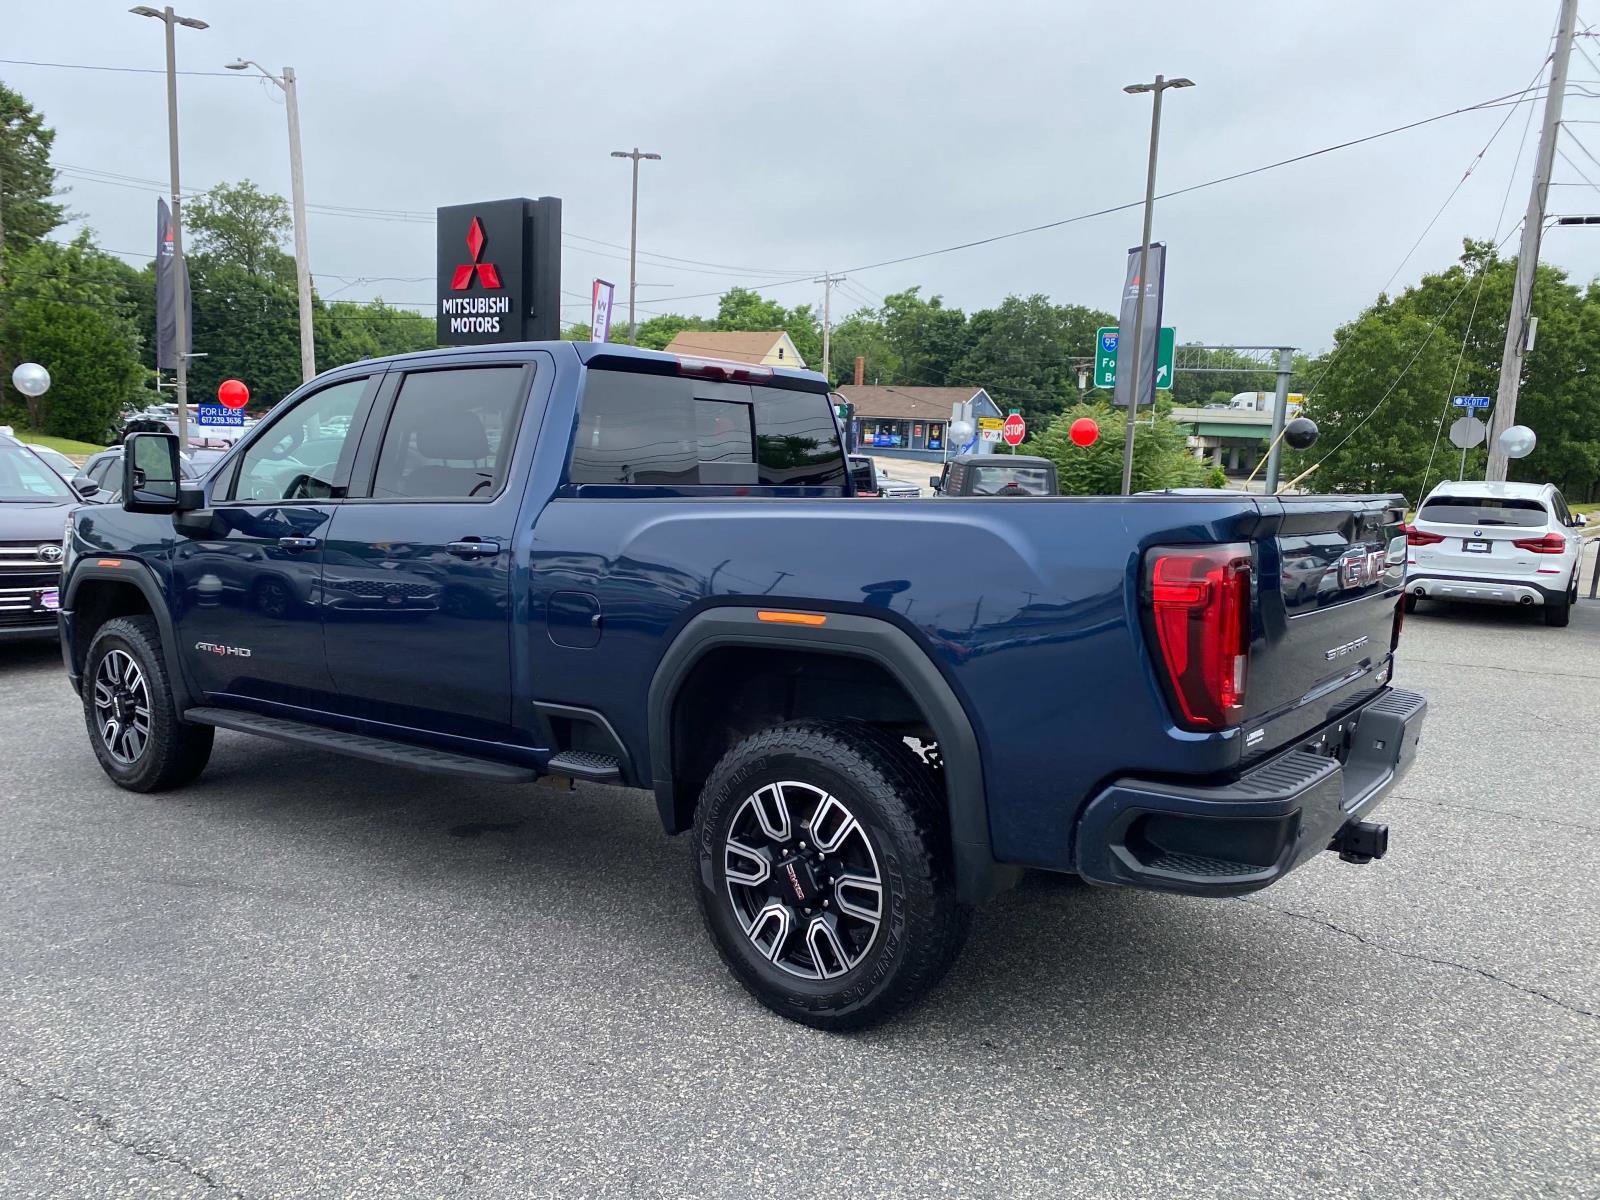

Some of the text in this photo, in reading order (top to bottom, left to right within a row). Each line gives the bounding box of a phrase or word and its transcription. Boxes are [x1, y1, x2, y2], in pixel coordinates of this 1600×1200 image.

[442, 297, 509, 315] MITSUBISHI
[450, 317, 500, 333] MOTORS
[1104, 338, 1116, 347] 95
[1463, 397, 1483, 406] SCOTT
[200, 407, 242, 417] FOR LEASE
[201, 416, 242, 425] 617.239.3636
[1005, 423, 1024, 436] STOP
[1340, 551, 1385, 590] GMC
[195, 642, 251, 657] AT4 HD
[1326, 635, 1369, 661] SIERRA
